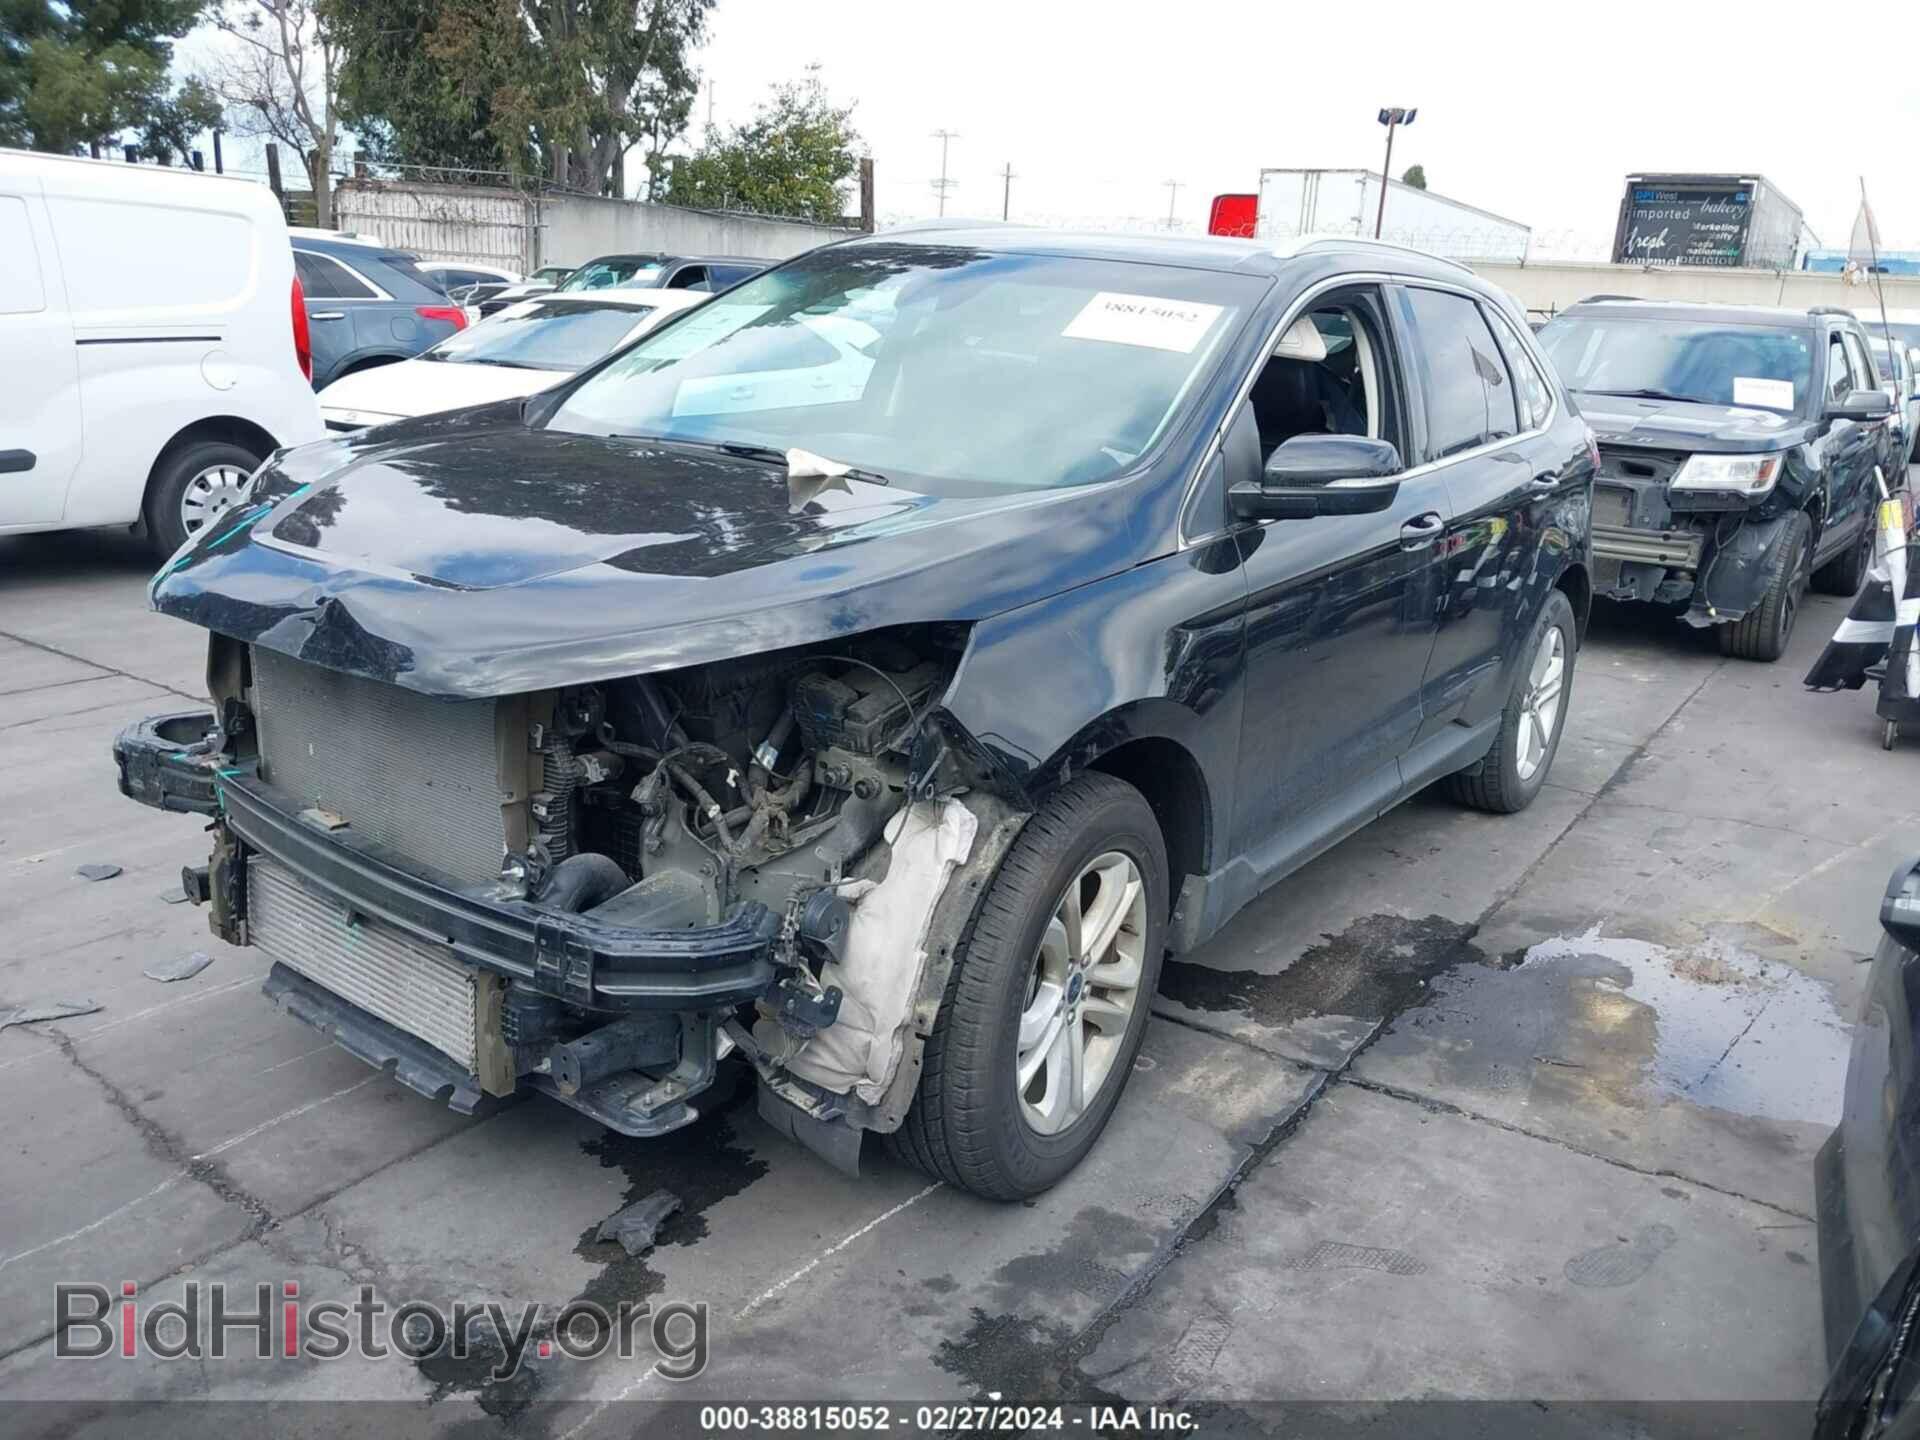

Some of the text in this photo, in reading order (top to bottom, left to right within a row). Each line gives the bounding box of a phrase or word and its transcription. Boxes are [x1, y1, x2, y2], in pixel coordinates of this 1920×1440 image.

[1632, 208, 1691, 220] imported
[1699, 196, 1749, 219] bakery
[1625, 225, 1670, 255] fresh
